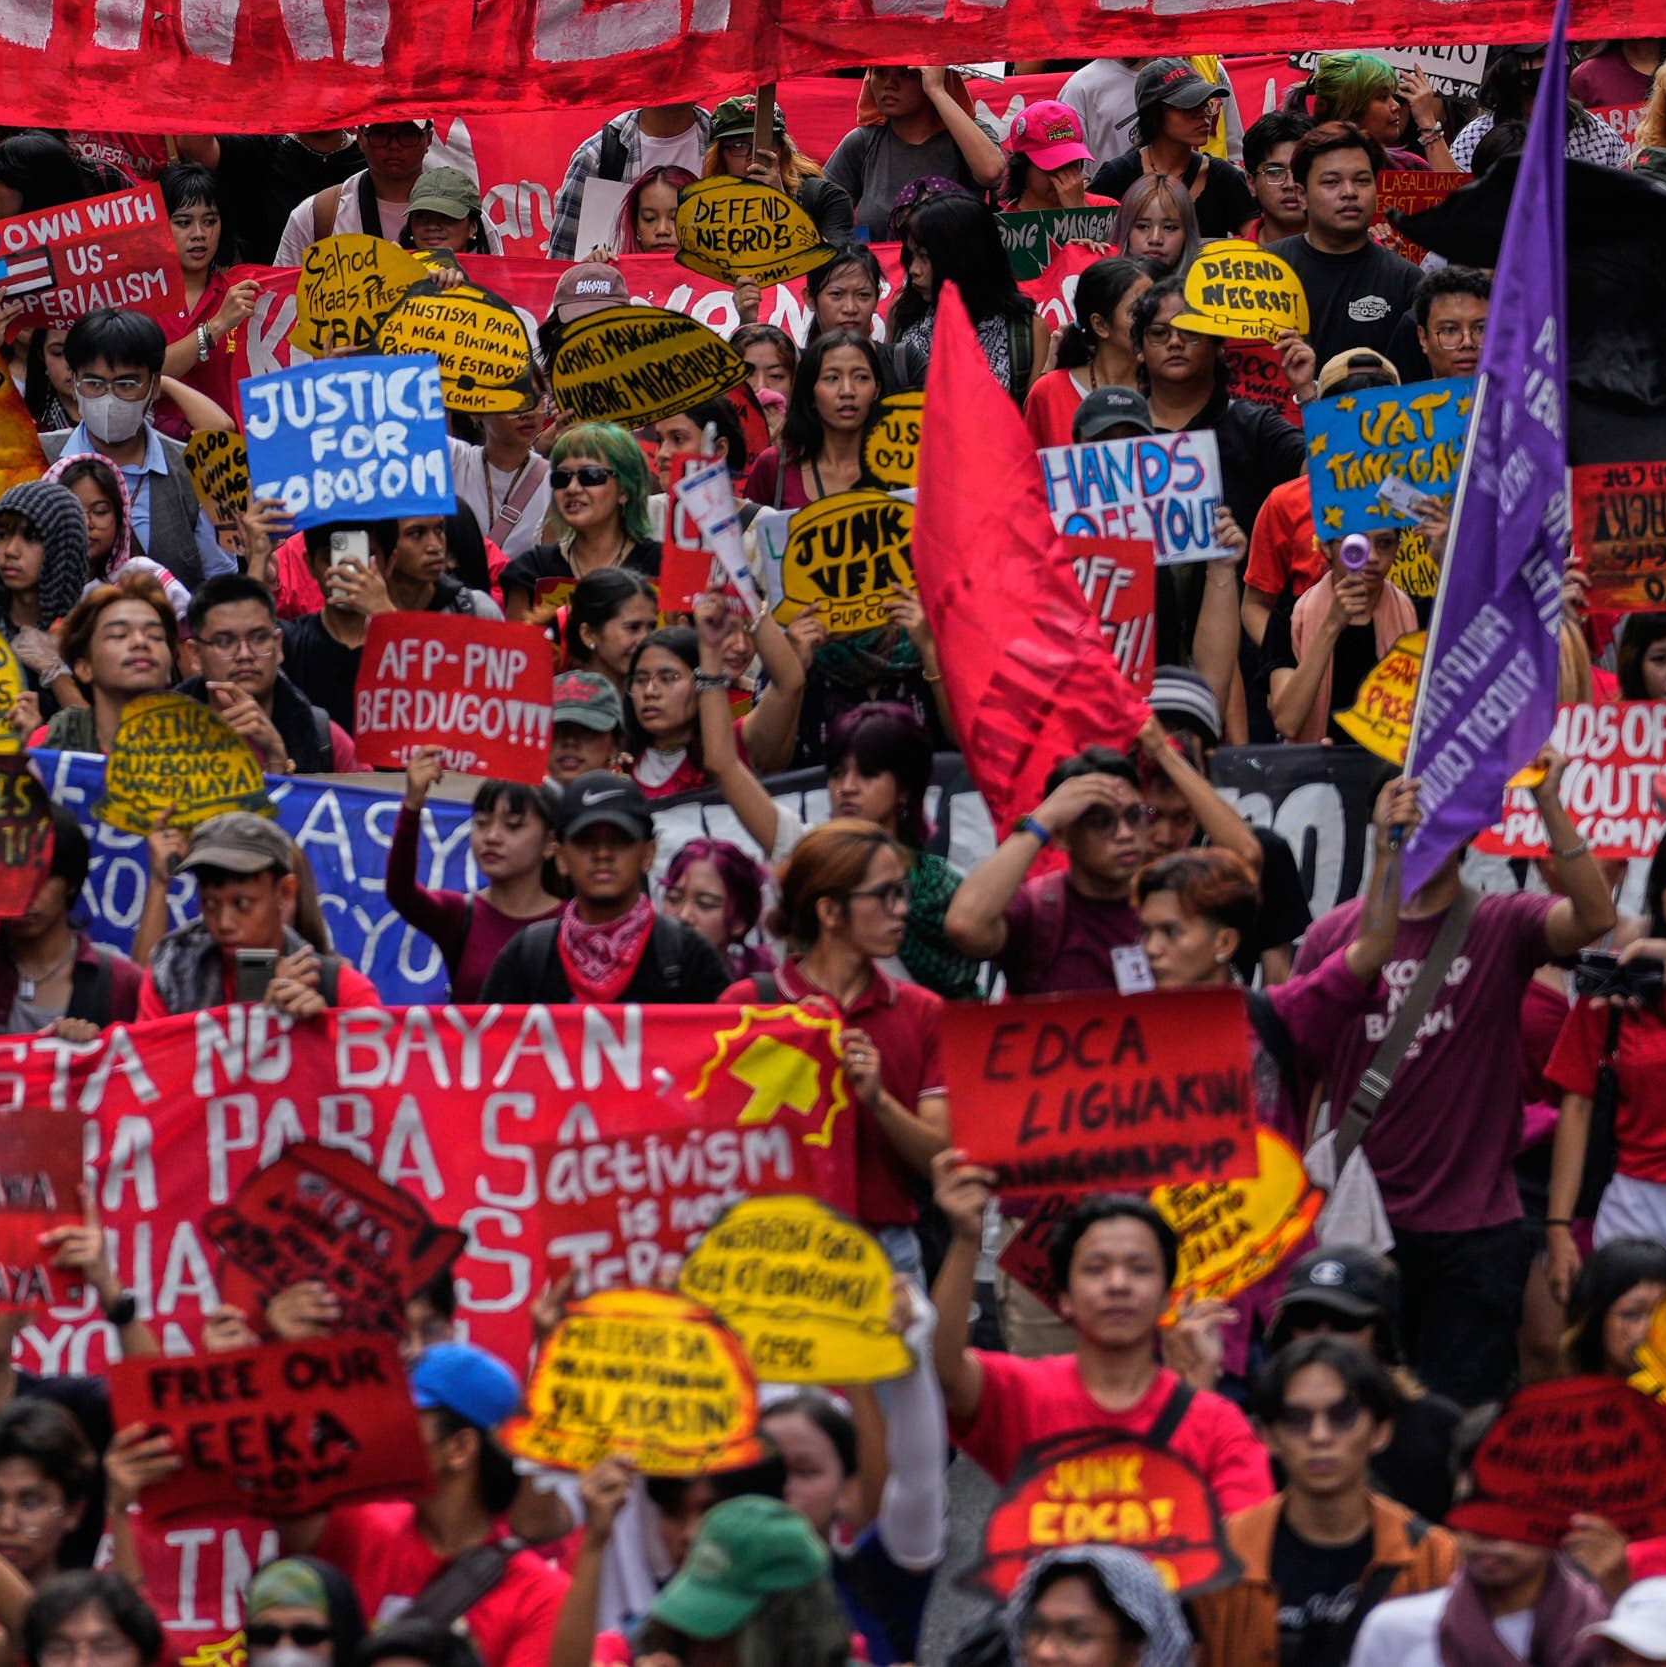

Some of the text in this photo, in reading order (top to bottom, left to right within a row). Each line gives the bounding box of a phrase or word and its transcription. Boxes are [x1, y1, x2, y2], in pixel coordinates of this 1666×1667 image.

[86, 192, 157, 229] WITH
[694, 196, 791, 225] DEFEND
[1376, 195, 1417, 215] ESIST
[695, 224, 792, 253] NEGROS
[1201, 257, 1284, 282] DEFEND
[1201, 283, 1299, 321] NEGROS!
[383, 319, 404, 335] SA
[411, 324, 447, 343] MGA
[453, 330, 509, 359] BIKTIMA
[484, 316, 521, 341] PARA
[1241, 324, 1266, 336] PUP
[458, 353, 523, 381] ESTADO!
[245, 366, 445, 440] JUSTICE
[1358, 387, 1435, 445] VAT
[309, 419, 409, 463] FOR
[1039, 432, 1205, 513] HANDS
[792, 504, 911, 567] JUNK
[829, 607, 862, 627] PUP
[355, 687, 553, 751] BERDUGO!!!
[984, 1016, 1149, 1083] EDCA
[617, 1197, 660, 1238] is
[147, 1346, 389, 1411] FREE OUR
[1044, 1455, 1144, 1500] JUNK
[1029, 1498, 1175, 1545] EDCA!
